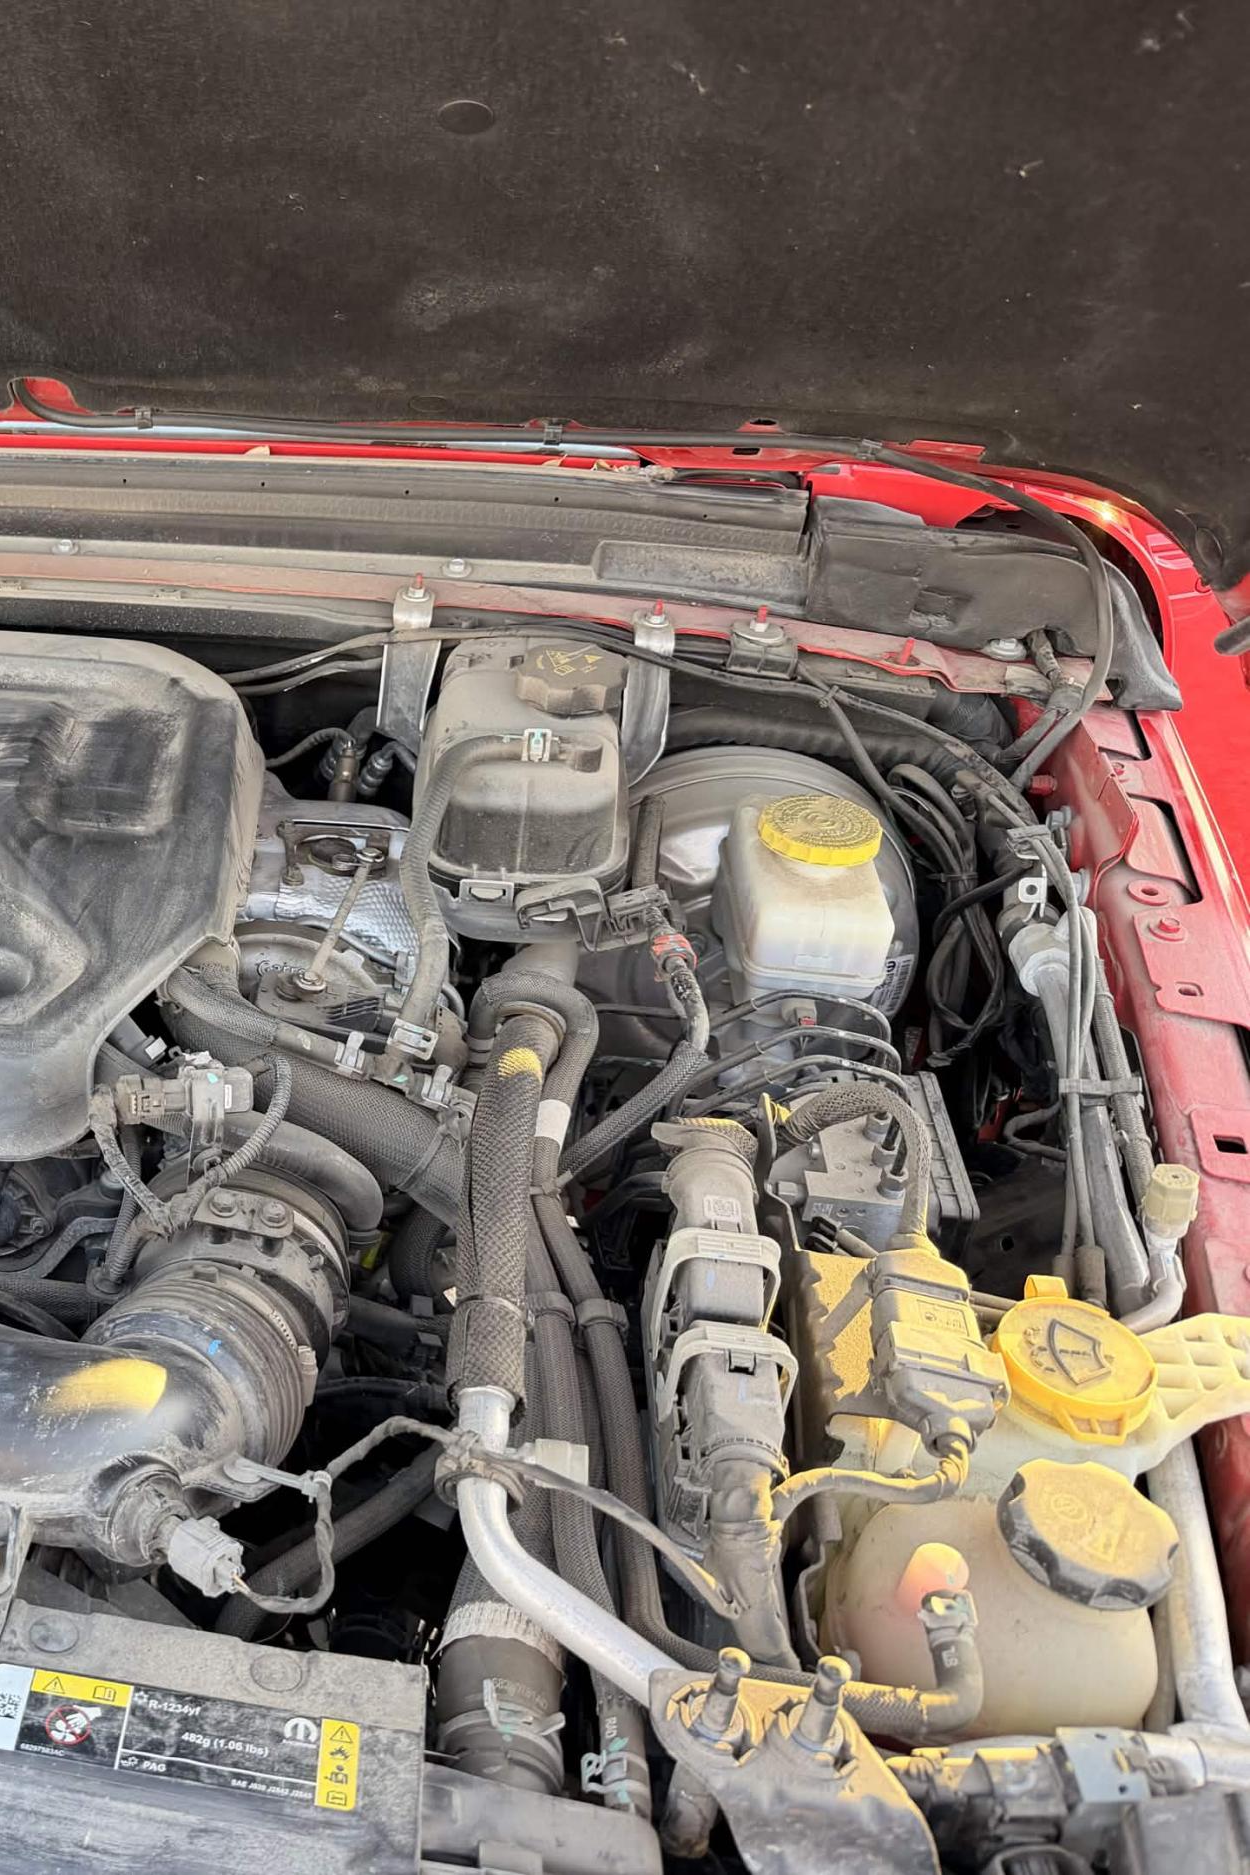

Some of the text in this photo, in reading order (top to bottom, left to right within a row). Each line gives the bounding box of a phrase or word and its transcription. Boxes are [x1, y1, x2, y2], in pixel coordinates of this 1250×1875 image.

[149, 1698, 203, 1718] R-1234yf
[181, 1731, 210, 1749] 482g
[213, 1735, 244, 1753] (1.06
[246, 1742, 270, 1758] lbs)
[142, 1760, 167, 1773] PAG
